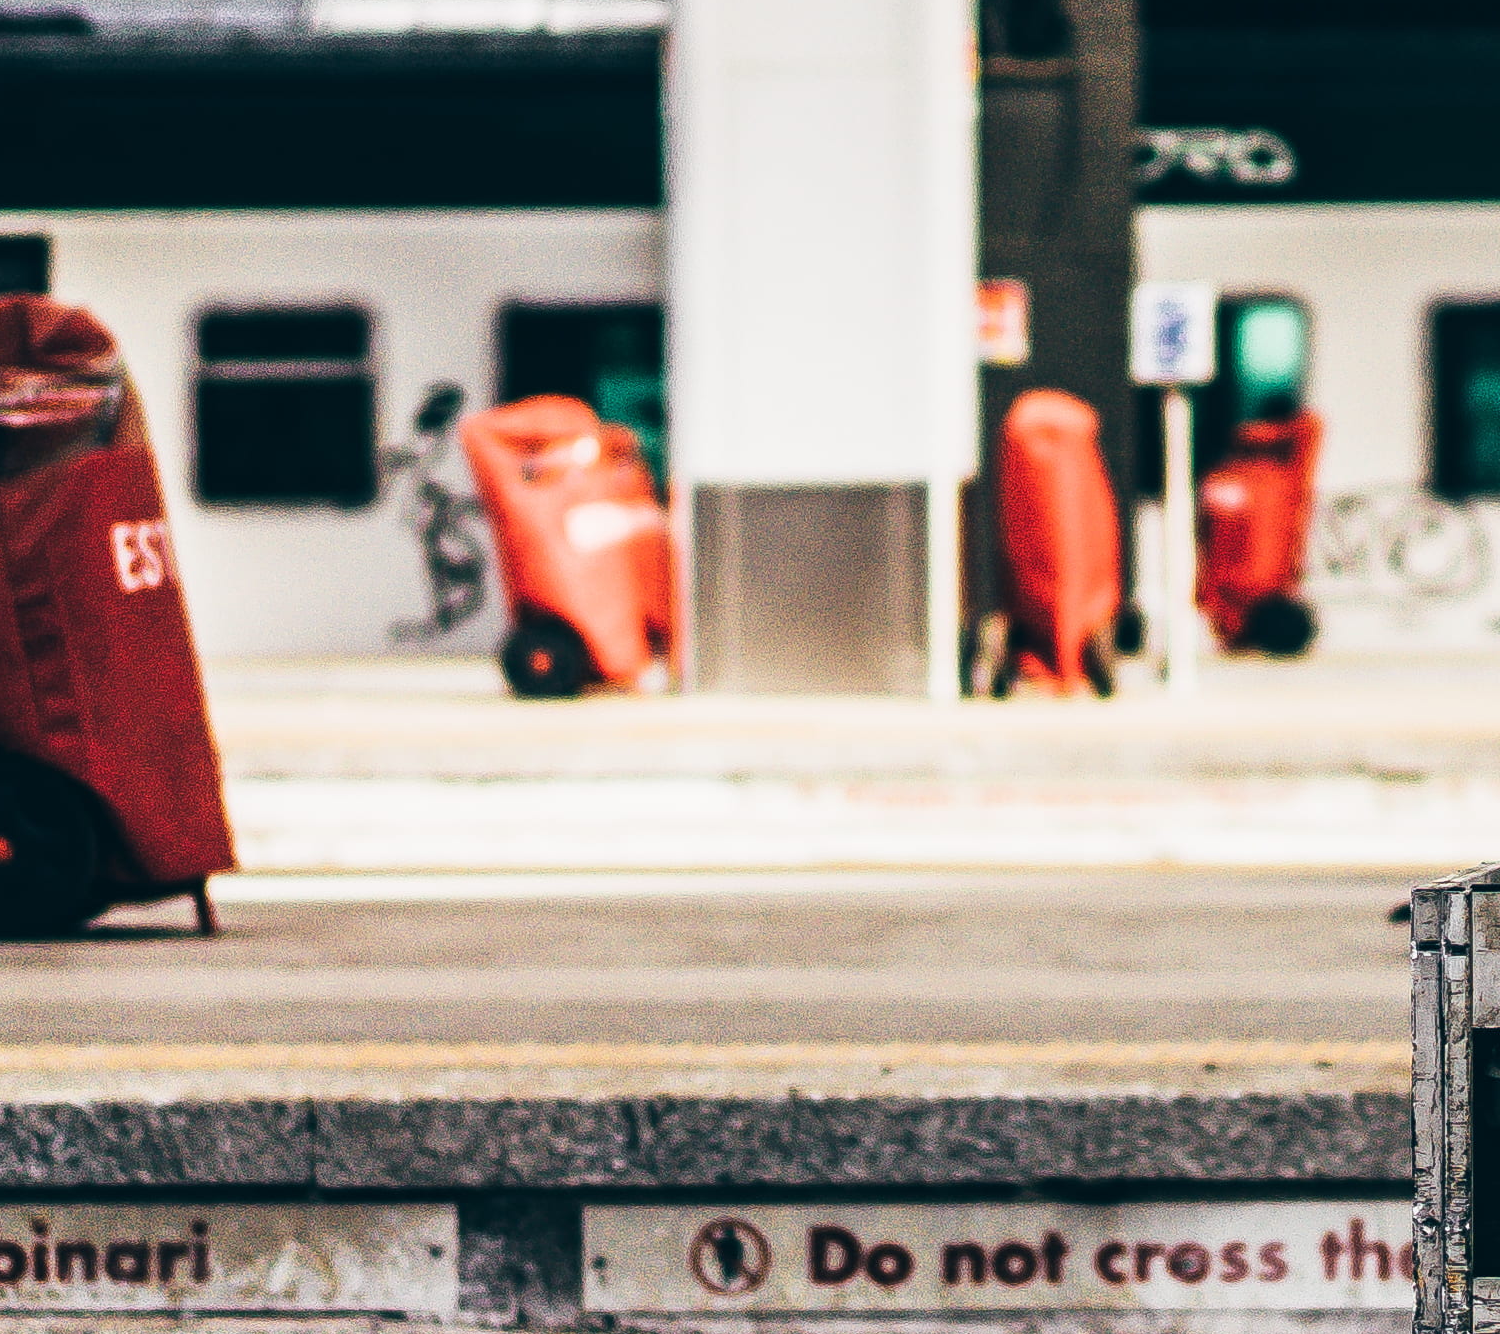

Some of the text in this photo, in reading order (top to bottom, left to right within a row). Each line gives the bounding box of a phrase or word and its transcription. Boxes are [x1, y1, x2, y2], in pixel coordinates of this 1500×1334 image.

[807, 1223, 914, 1286] Do
[941, 1229, 1069, 1286] not
[1095, 1239, 1288, 1286] cross
